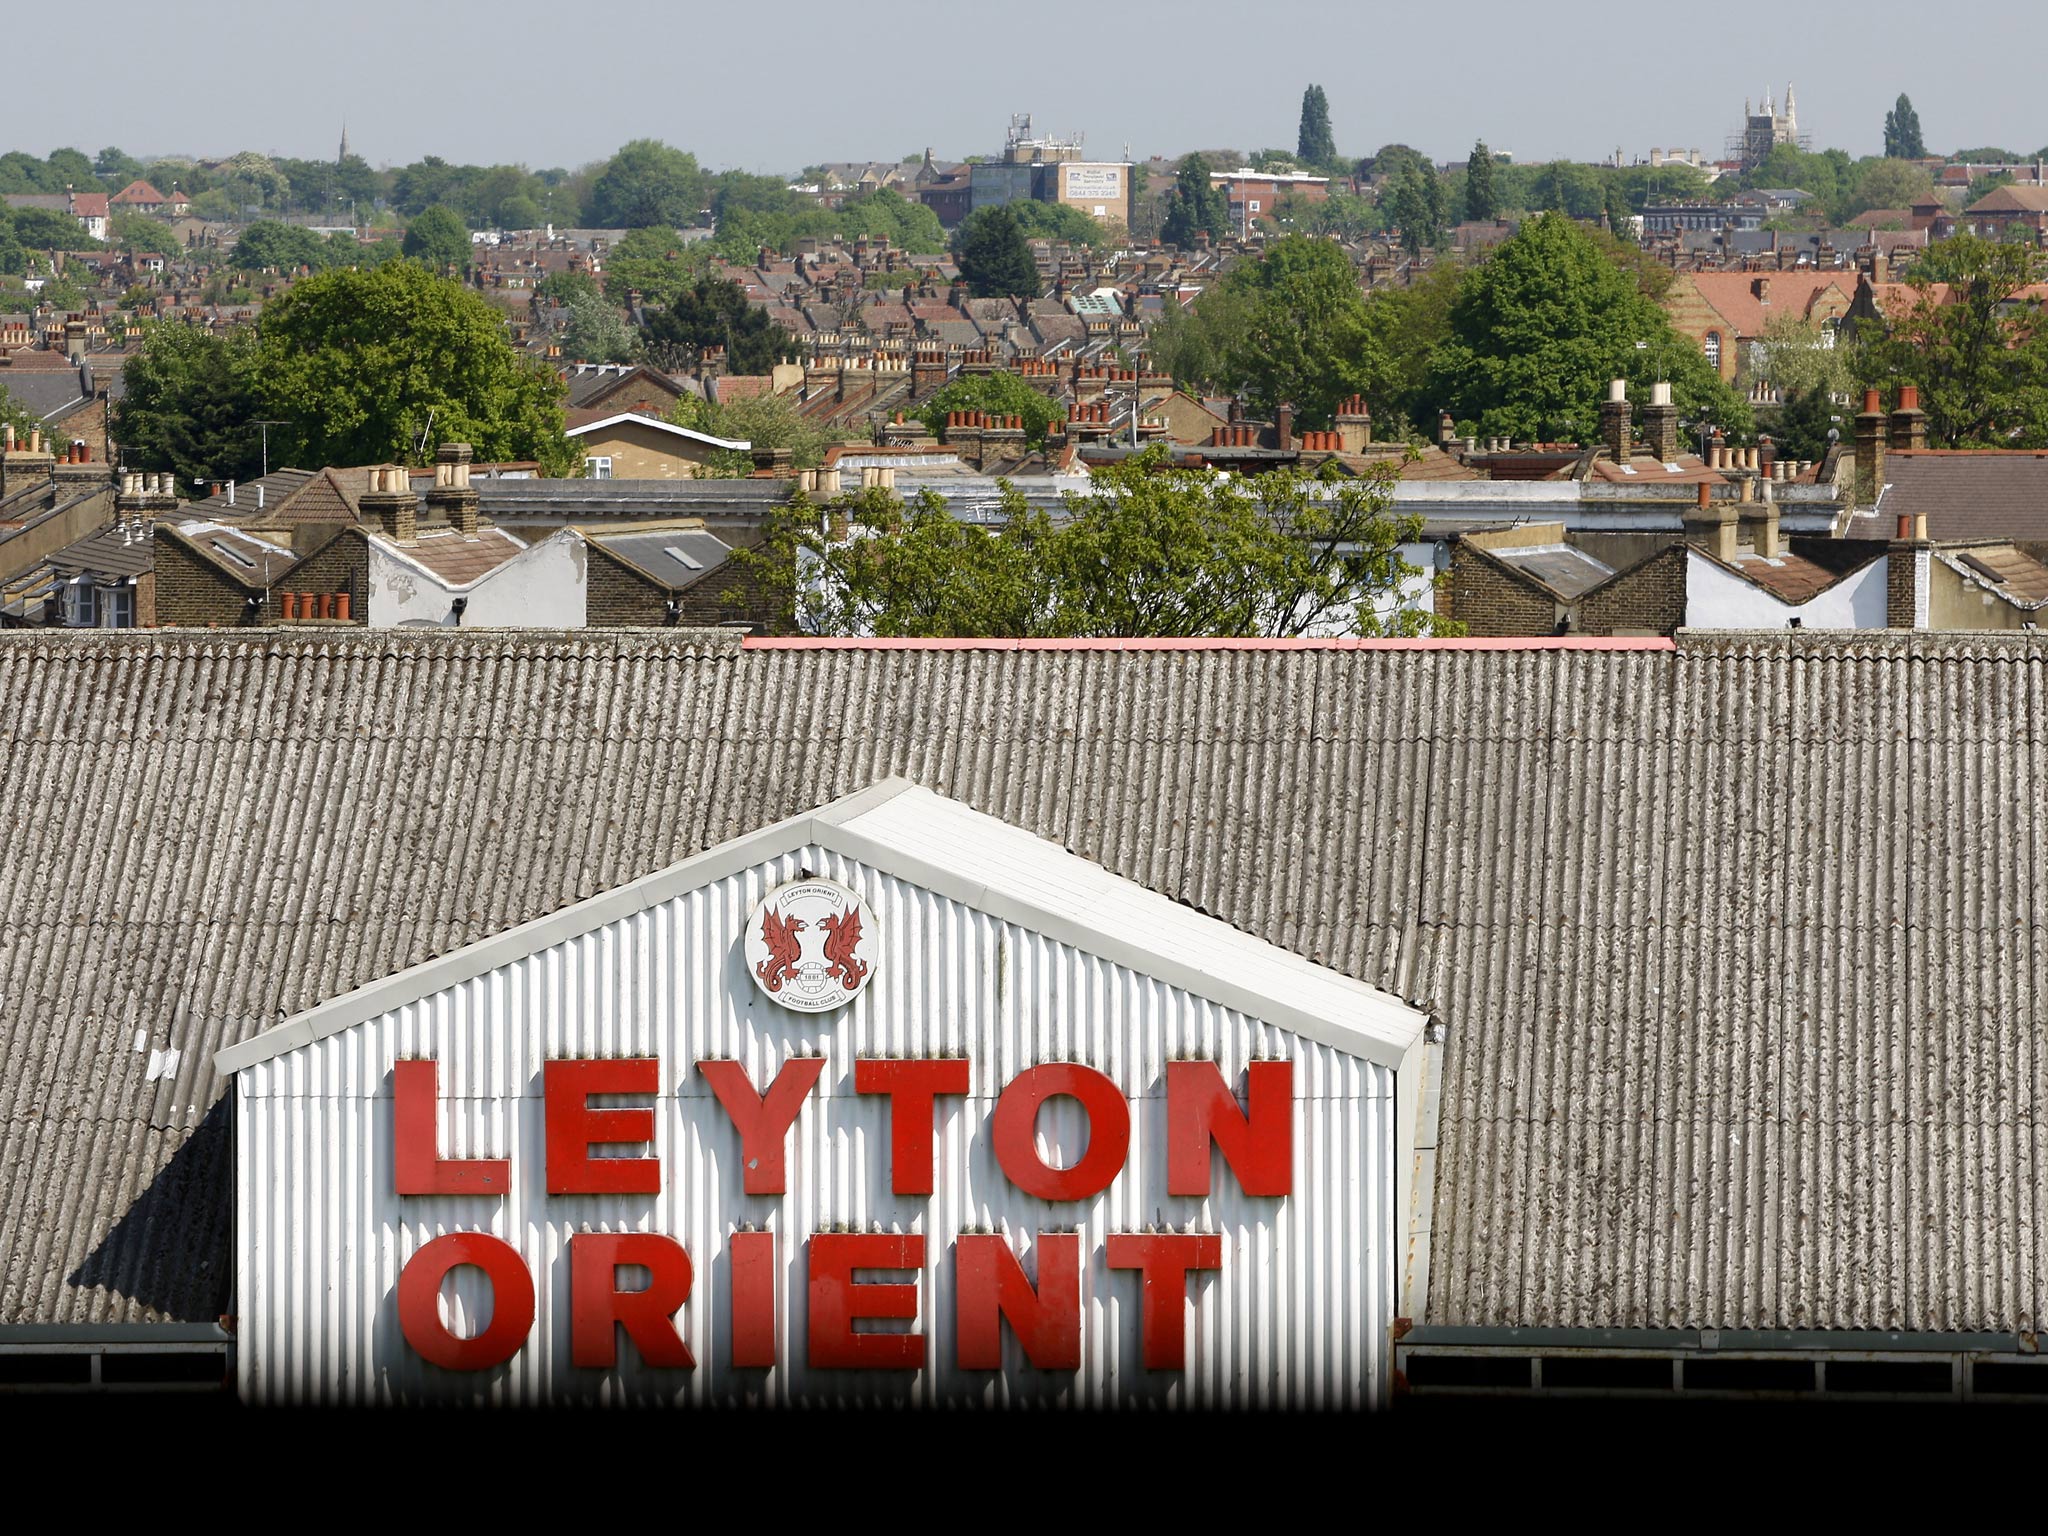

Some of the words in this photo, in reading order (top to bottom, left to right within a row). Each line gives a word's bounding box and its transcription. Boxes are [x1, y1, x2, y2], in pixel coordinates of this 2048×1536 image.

[787, 888, 811, 898] LEYTON
[812, 888, 836, 897] ORIENT
[788, 996, 819, 1006] FOOTBALL
[820, 996, 836, 1004] CLUB
[396, 1059, 1293, 1201] LEYTON
[399, 1233, 1221, 1368] ORIENT
